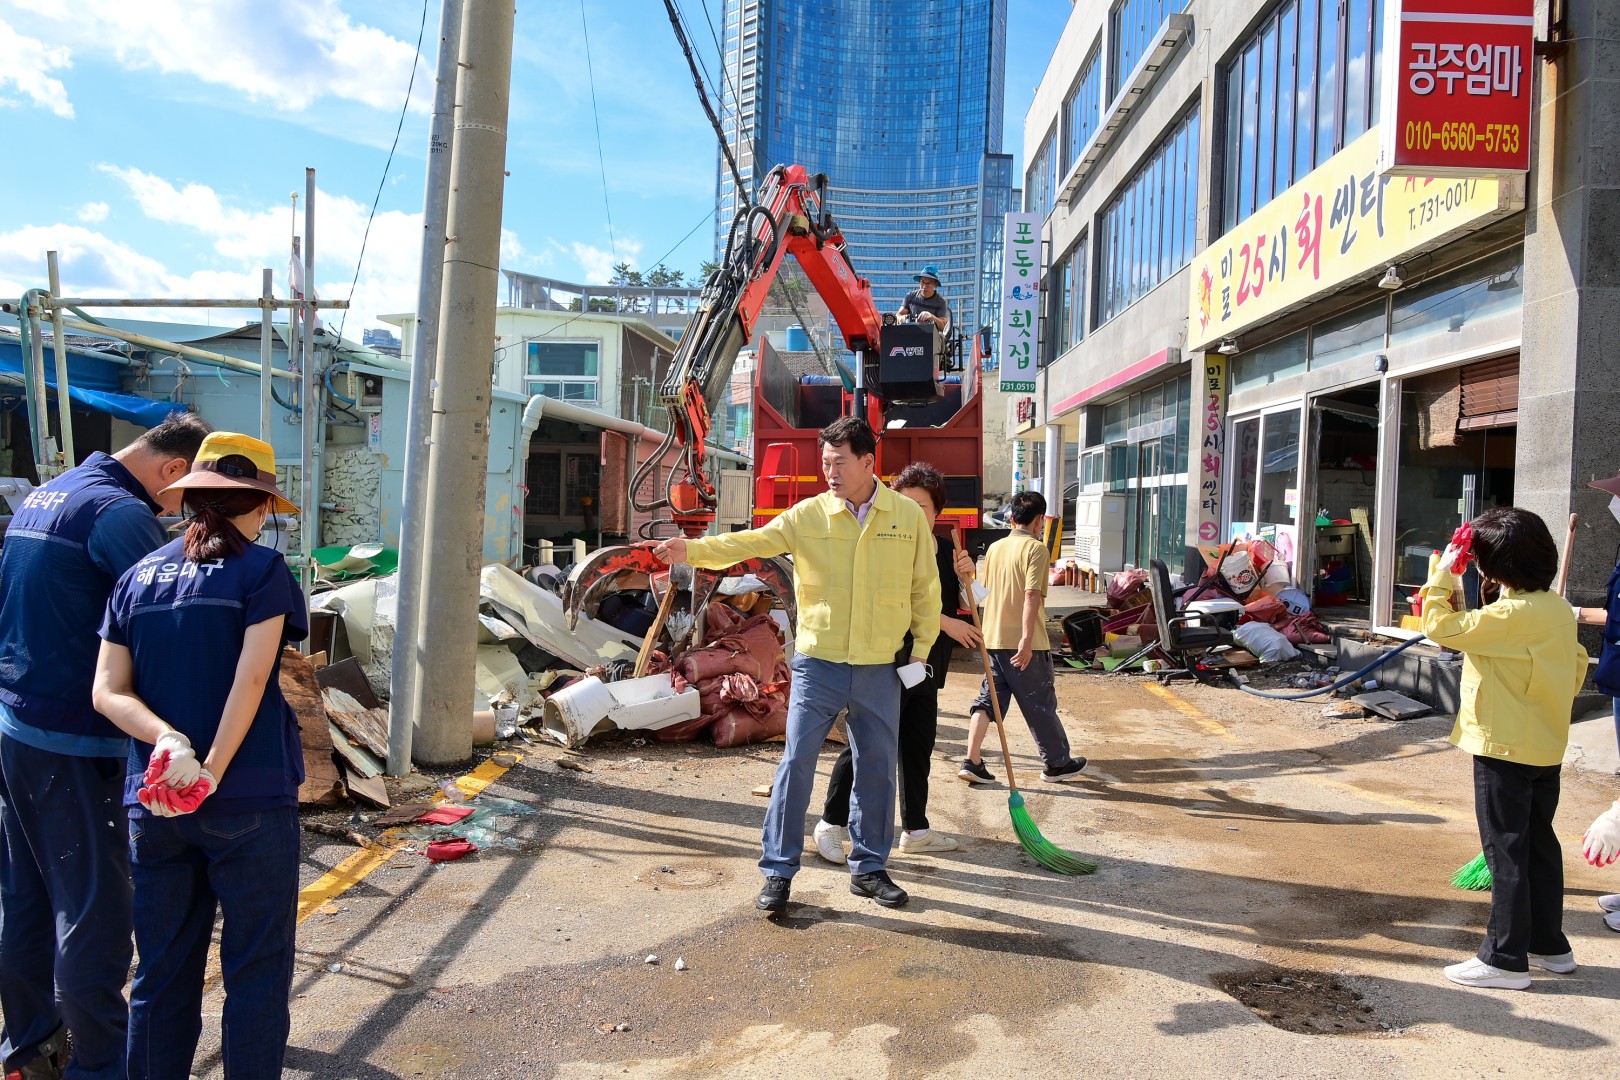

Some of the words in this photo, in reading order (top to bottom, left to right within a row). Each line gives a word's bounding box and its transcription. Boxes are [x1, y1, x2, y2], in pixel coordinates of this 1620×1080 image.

[1408, 42, 1523, 97] 공주엄마
[1405, 120, 1520, 153] 010-6560-5753
[1012, 222, 1035, 277] 포동
[1220, 247, 1233, 322] 미포
[1236, 225, 1287, 307] 25시
[1008, 309, 1032, 370] 횟집
[1001, 382, 1035, 391] 731.0519
[23, 490, 69, 511] 해운대구
[136, 558, 224, 585] 해운대구
